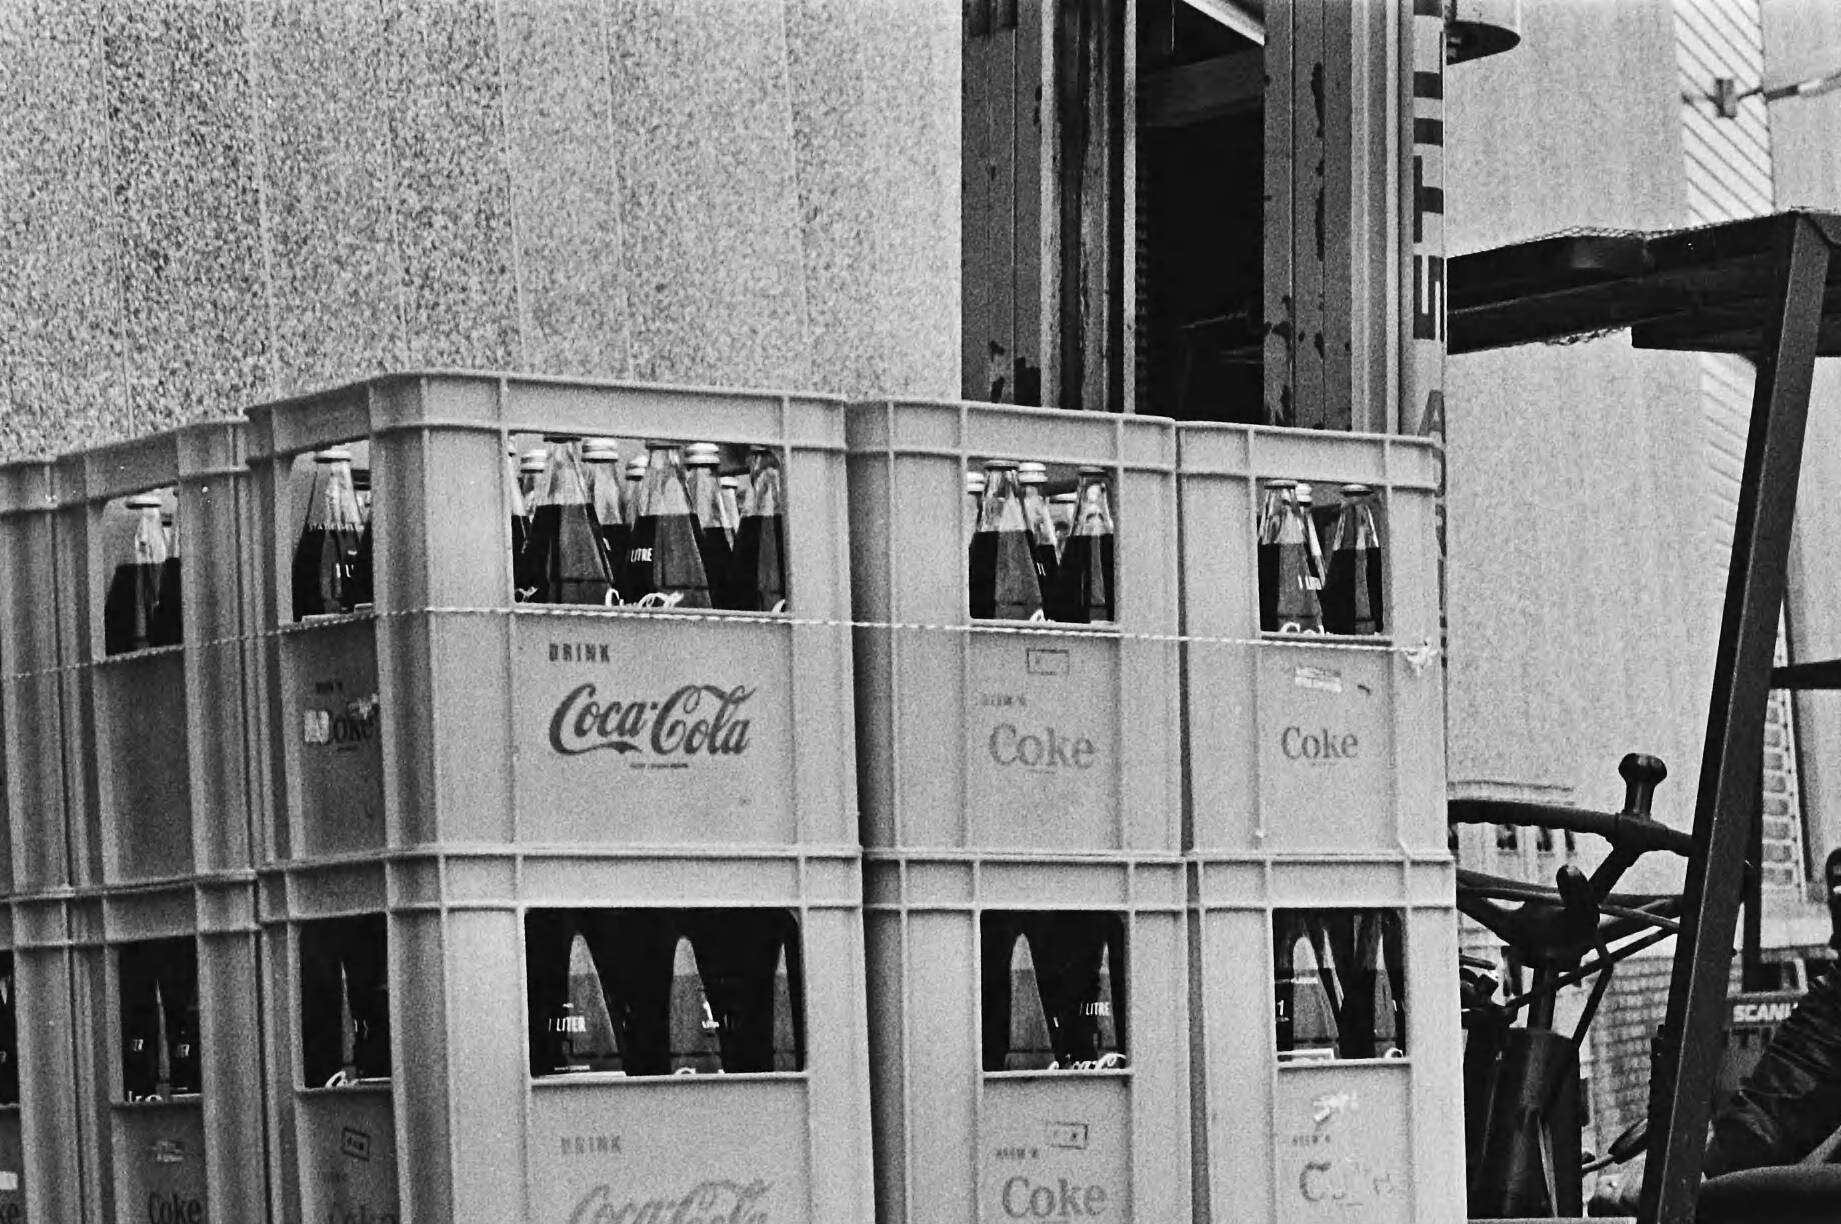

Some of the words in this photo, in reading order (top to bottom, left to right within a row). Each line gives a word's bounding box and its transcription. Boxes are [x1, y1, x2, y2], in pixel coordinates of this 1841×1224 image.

[549, 642, 610, 663] DRINK
[989, 722, 1096, 769] Coke
[1281, 726, 1359, 760] Coke
[1085, 1001, 1111, 1017] LITRE
[1733, 1001, 1798, 1022] SCANI
[556, 1015, 587, 1033] LITER
[1002, 1175, 1108, 1218] Coke
